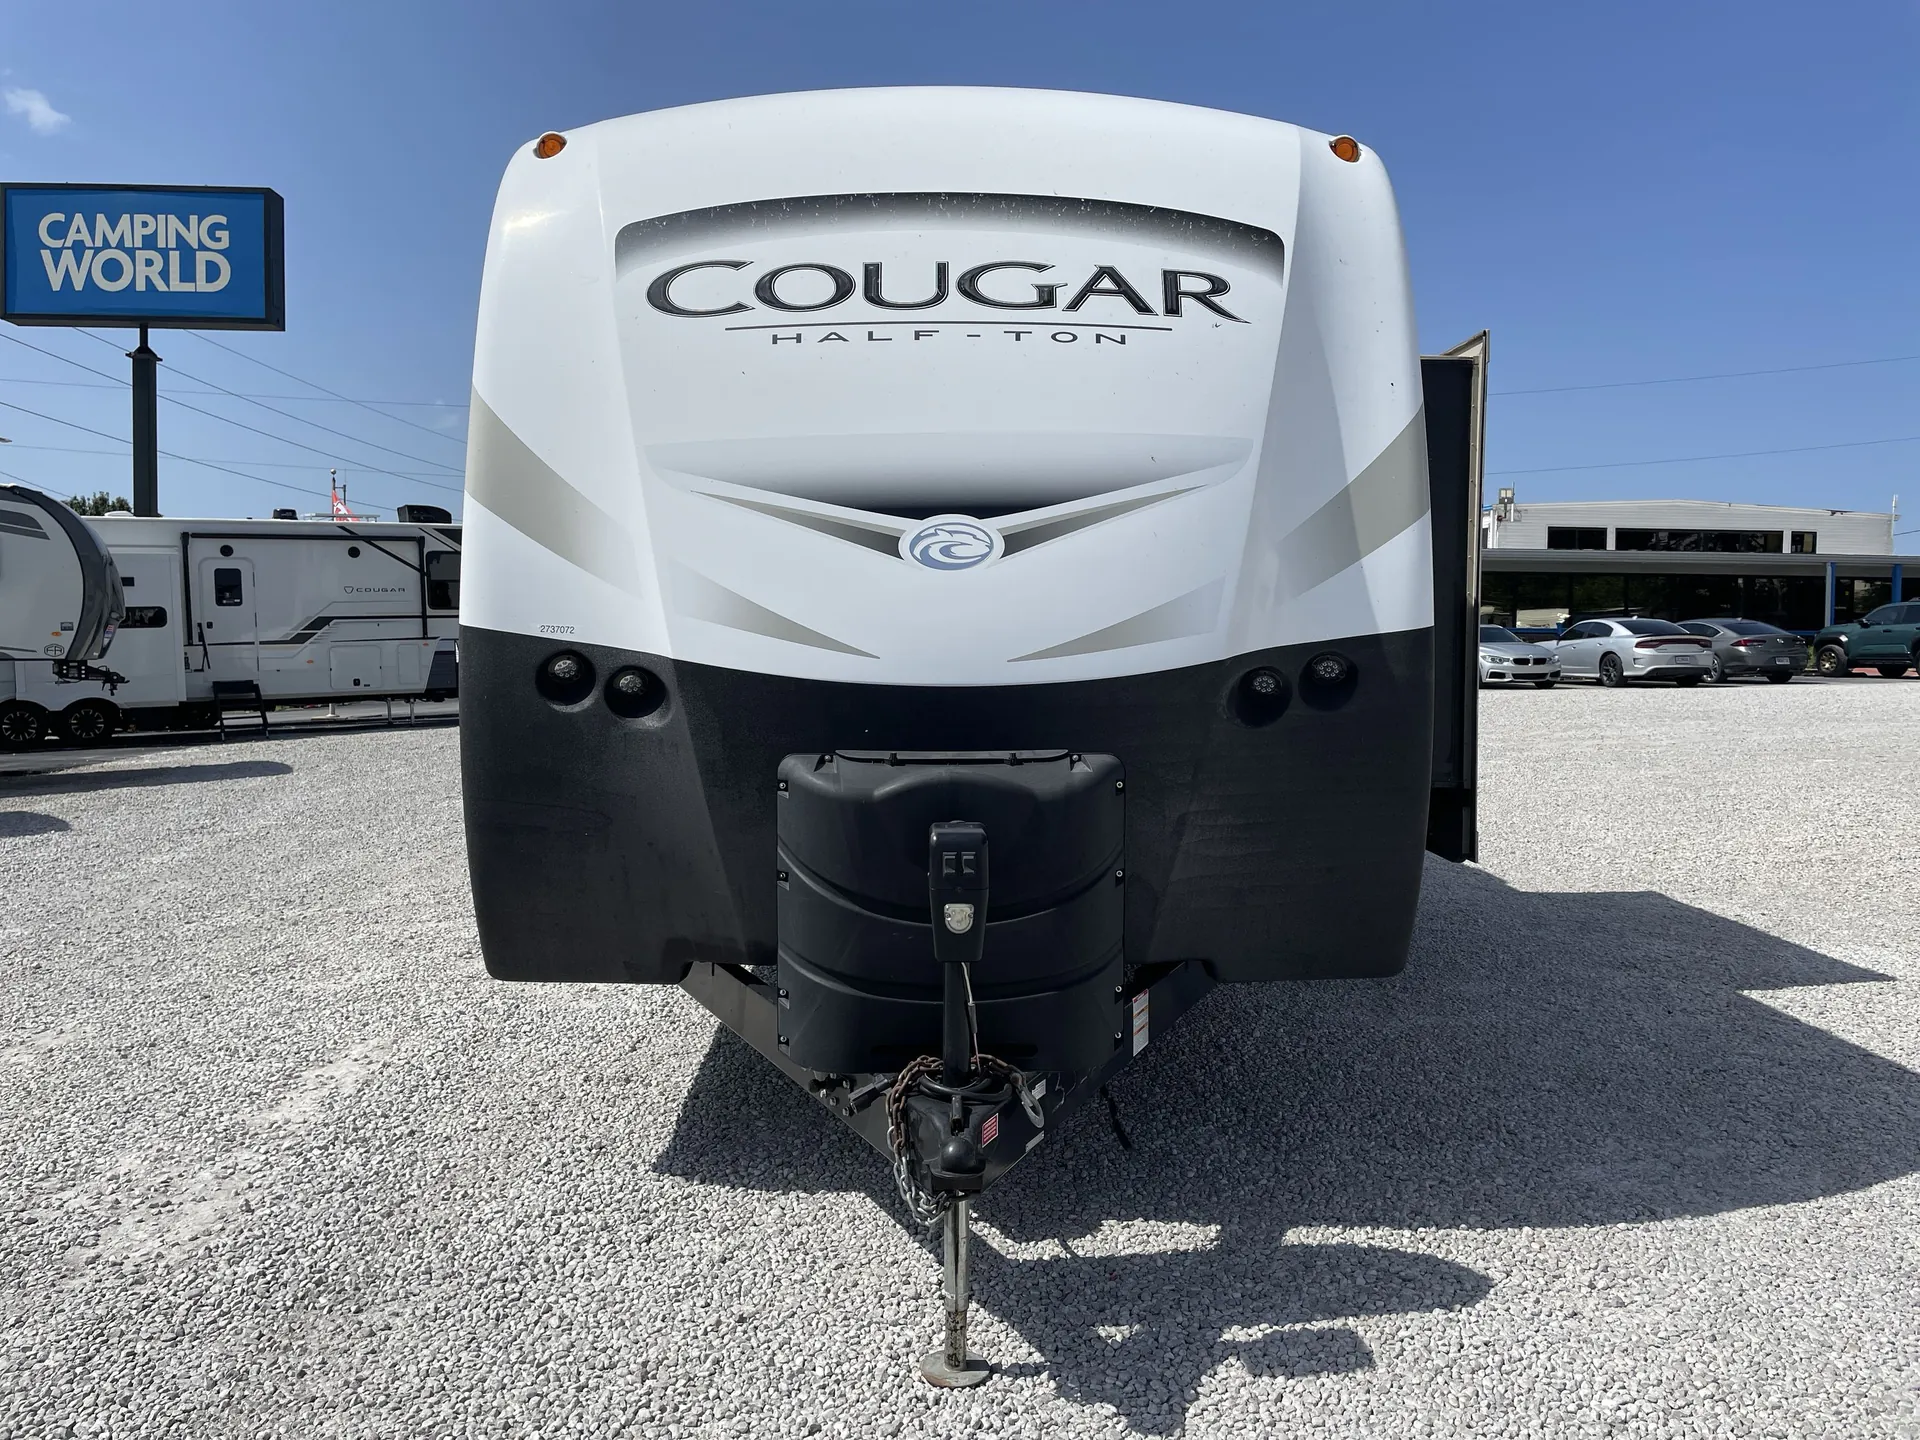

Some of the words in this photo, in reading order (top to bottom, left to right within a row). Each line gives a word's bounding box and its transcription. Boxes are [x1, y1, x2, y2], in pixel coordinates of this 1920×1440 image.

[38, 212, 230, 250] CAMPING
[40, 249, 232, 293] WORLD
[645, 259, 1252, 325] COUGAR
[540, 624, 575, 635] 2737072
